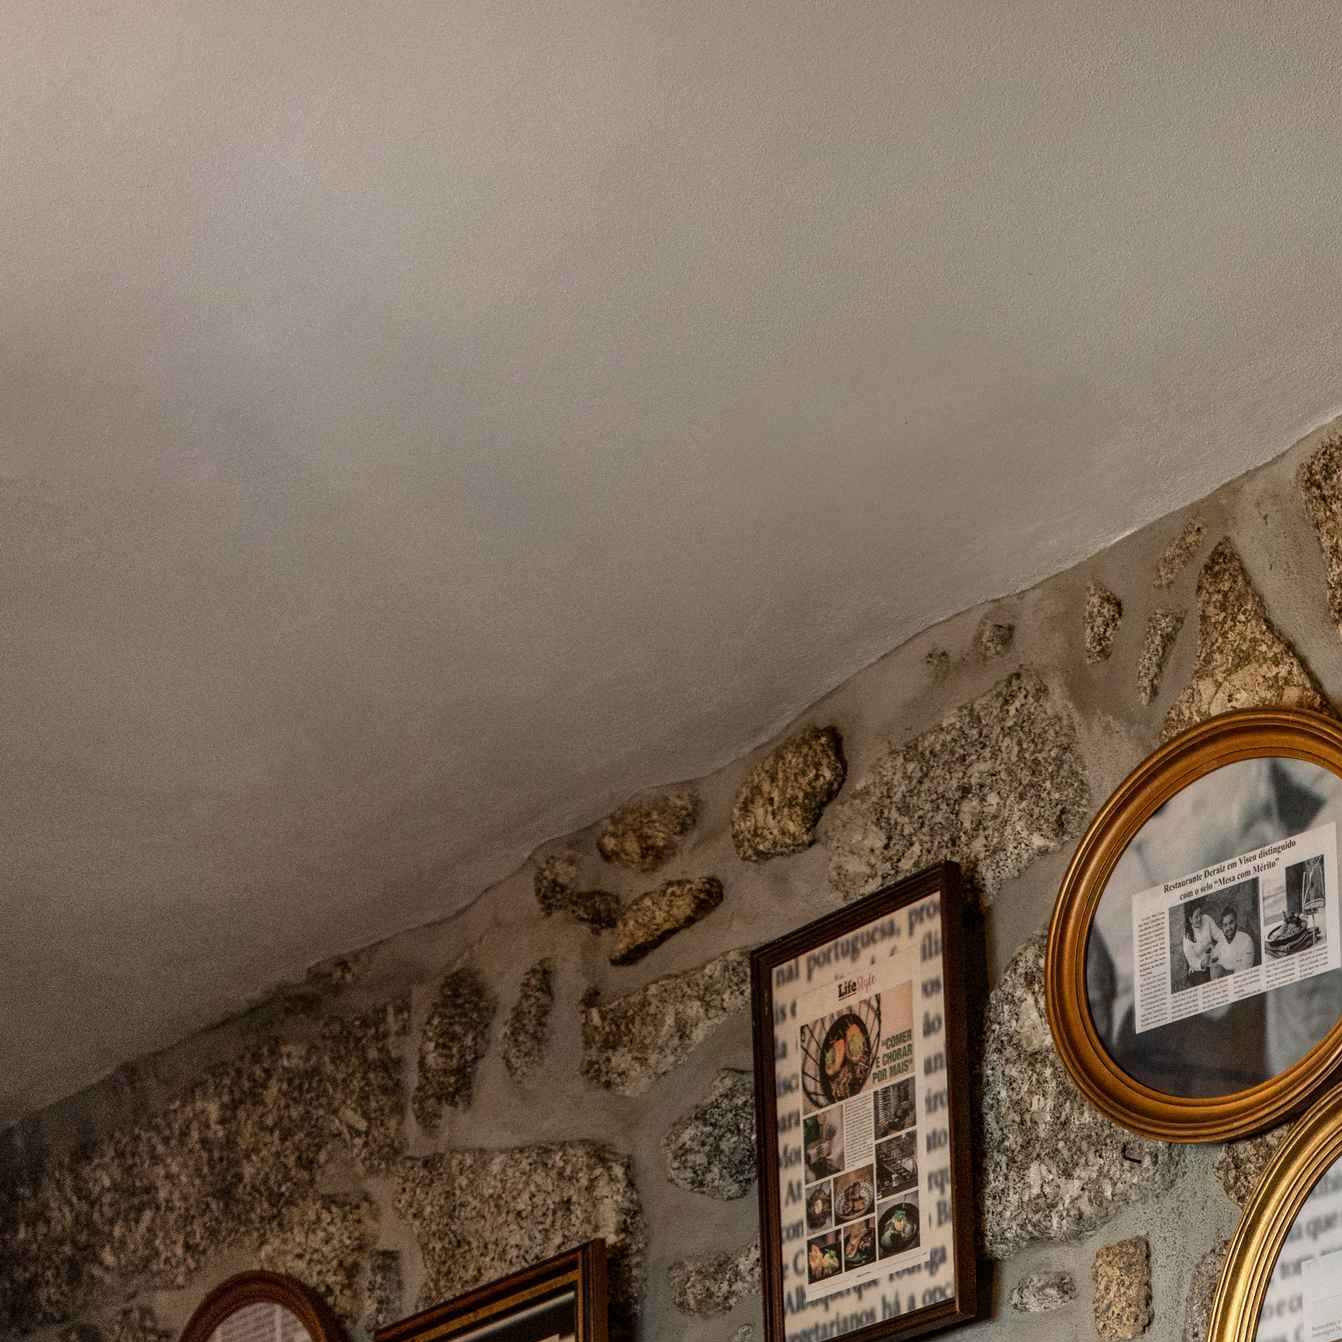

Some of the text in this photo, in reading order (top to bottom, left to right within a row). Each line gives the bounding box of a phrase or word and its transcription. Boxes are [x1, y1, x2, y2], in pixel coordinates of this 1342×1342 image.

[1163, 875, 1203, 893] Restaurante
[1226, 861, 1238, 871] em
[1238, 853, 1257, 866] Viseu
[1258, 840, 1297, 859] distinguido
[1236, 869, 1251, 880] com
